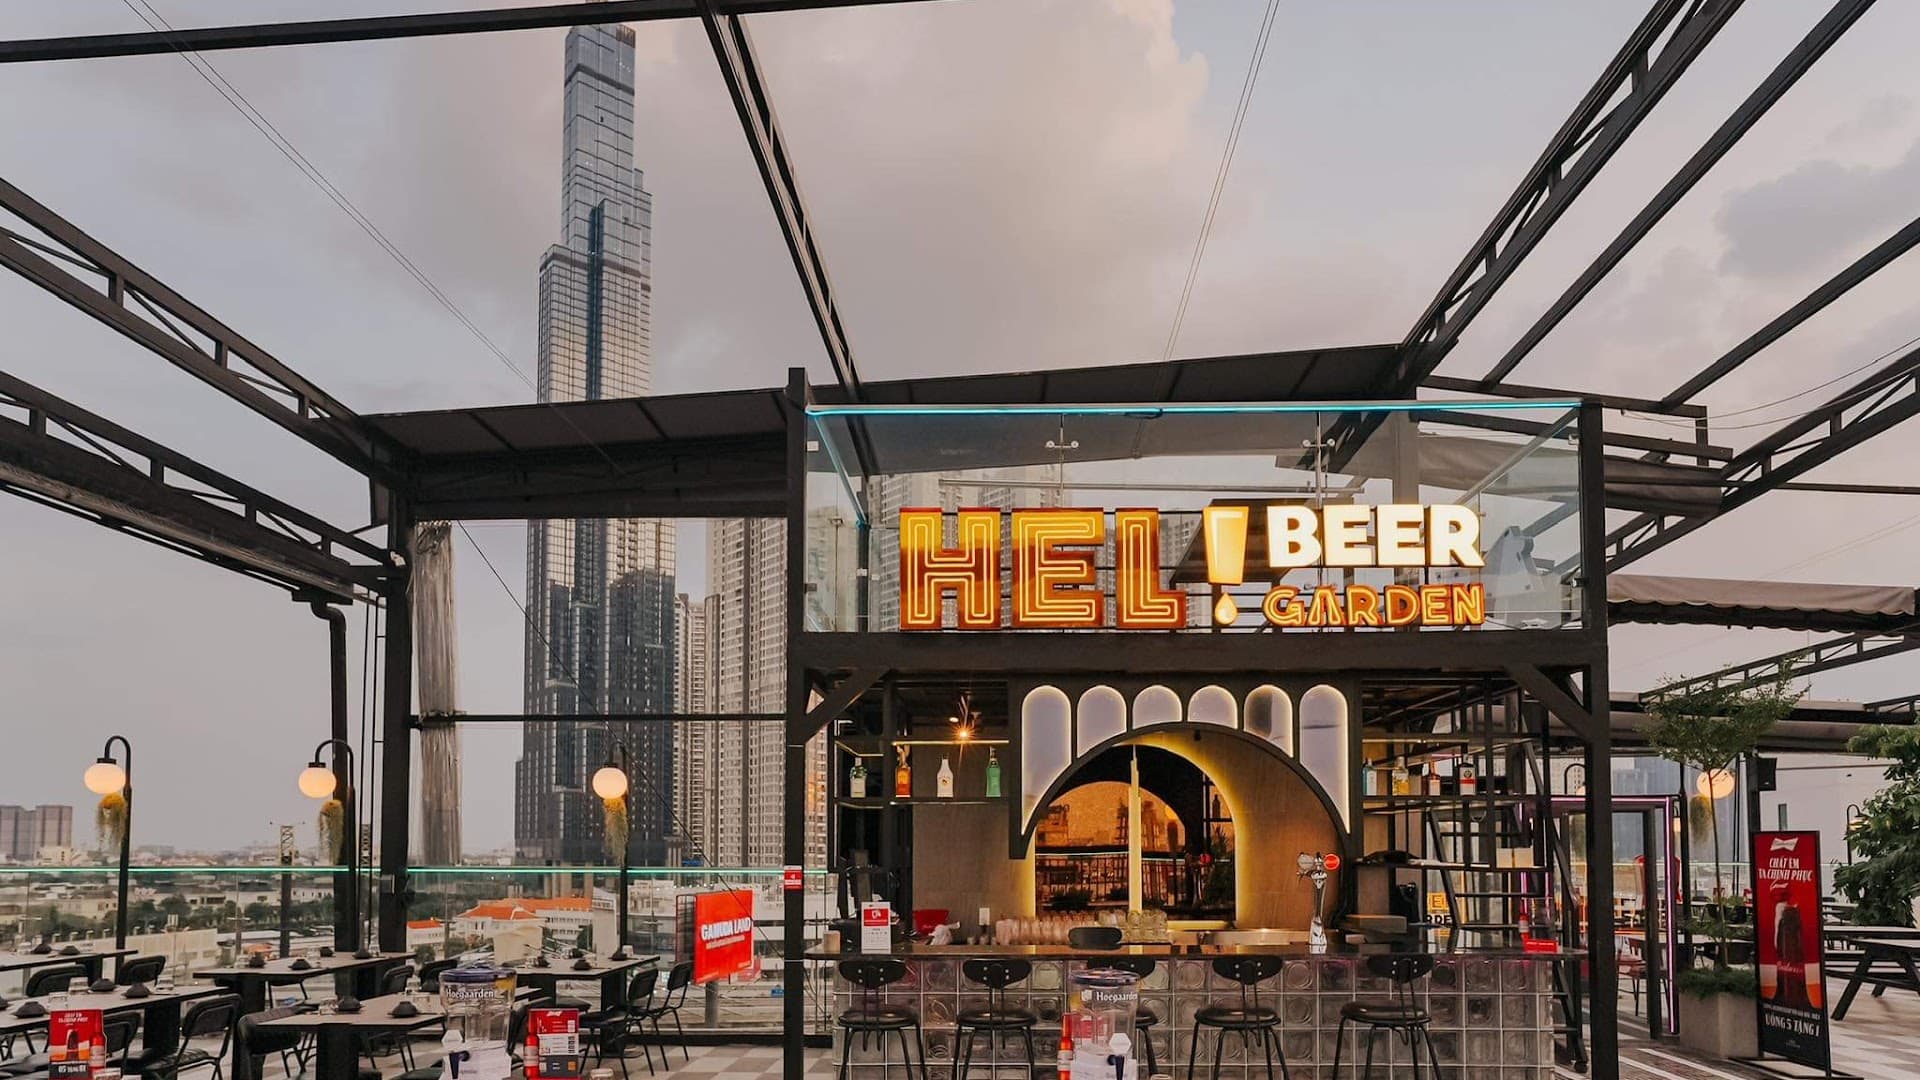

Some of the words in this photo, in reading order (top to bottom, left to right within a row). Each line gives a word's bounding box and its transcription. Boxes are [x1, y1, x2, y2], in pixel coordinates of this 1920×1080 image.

[1266, 504, 1486, 568] BEER
[1262, 583, 1485, 626] GARDEN
[446, 989, 494, 999] Hoegaarden
